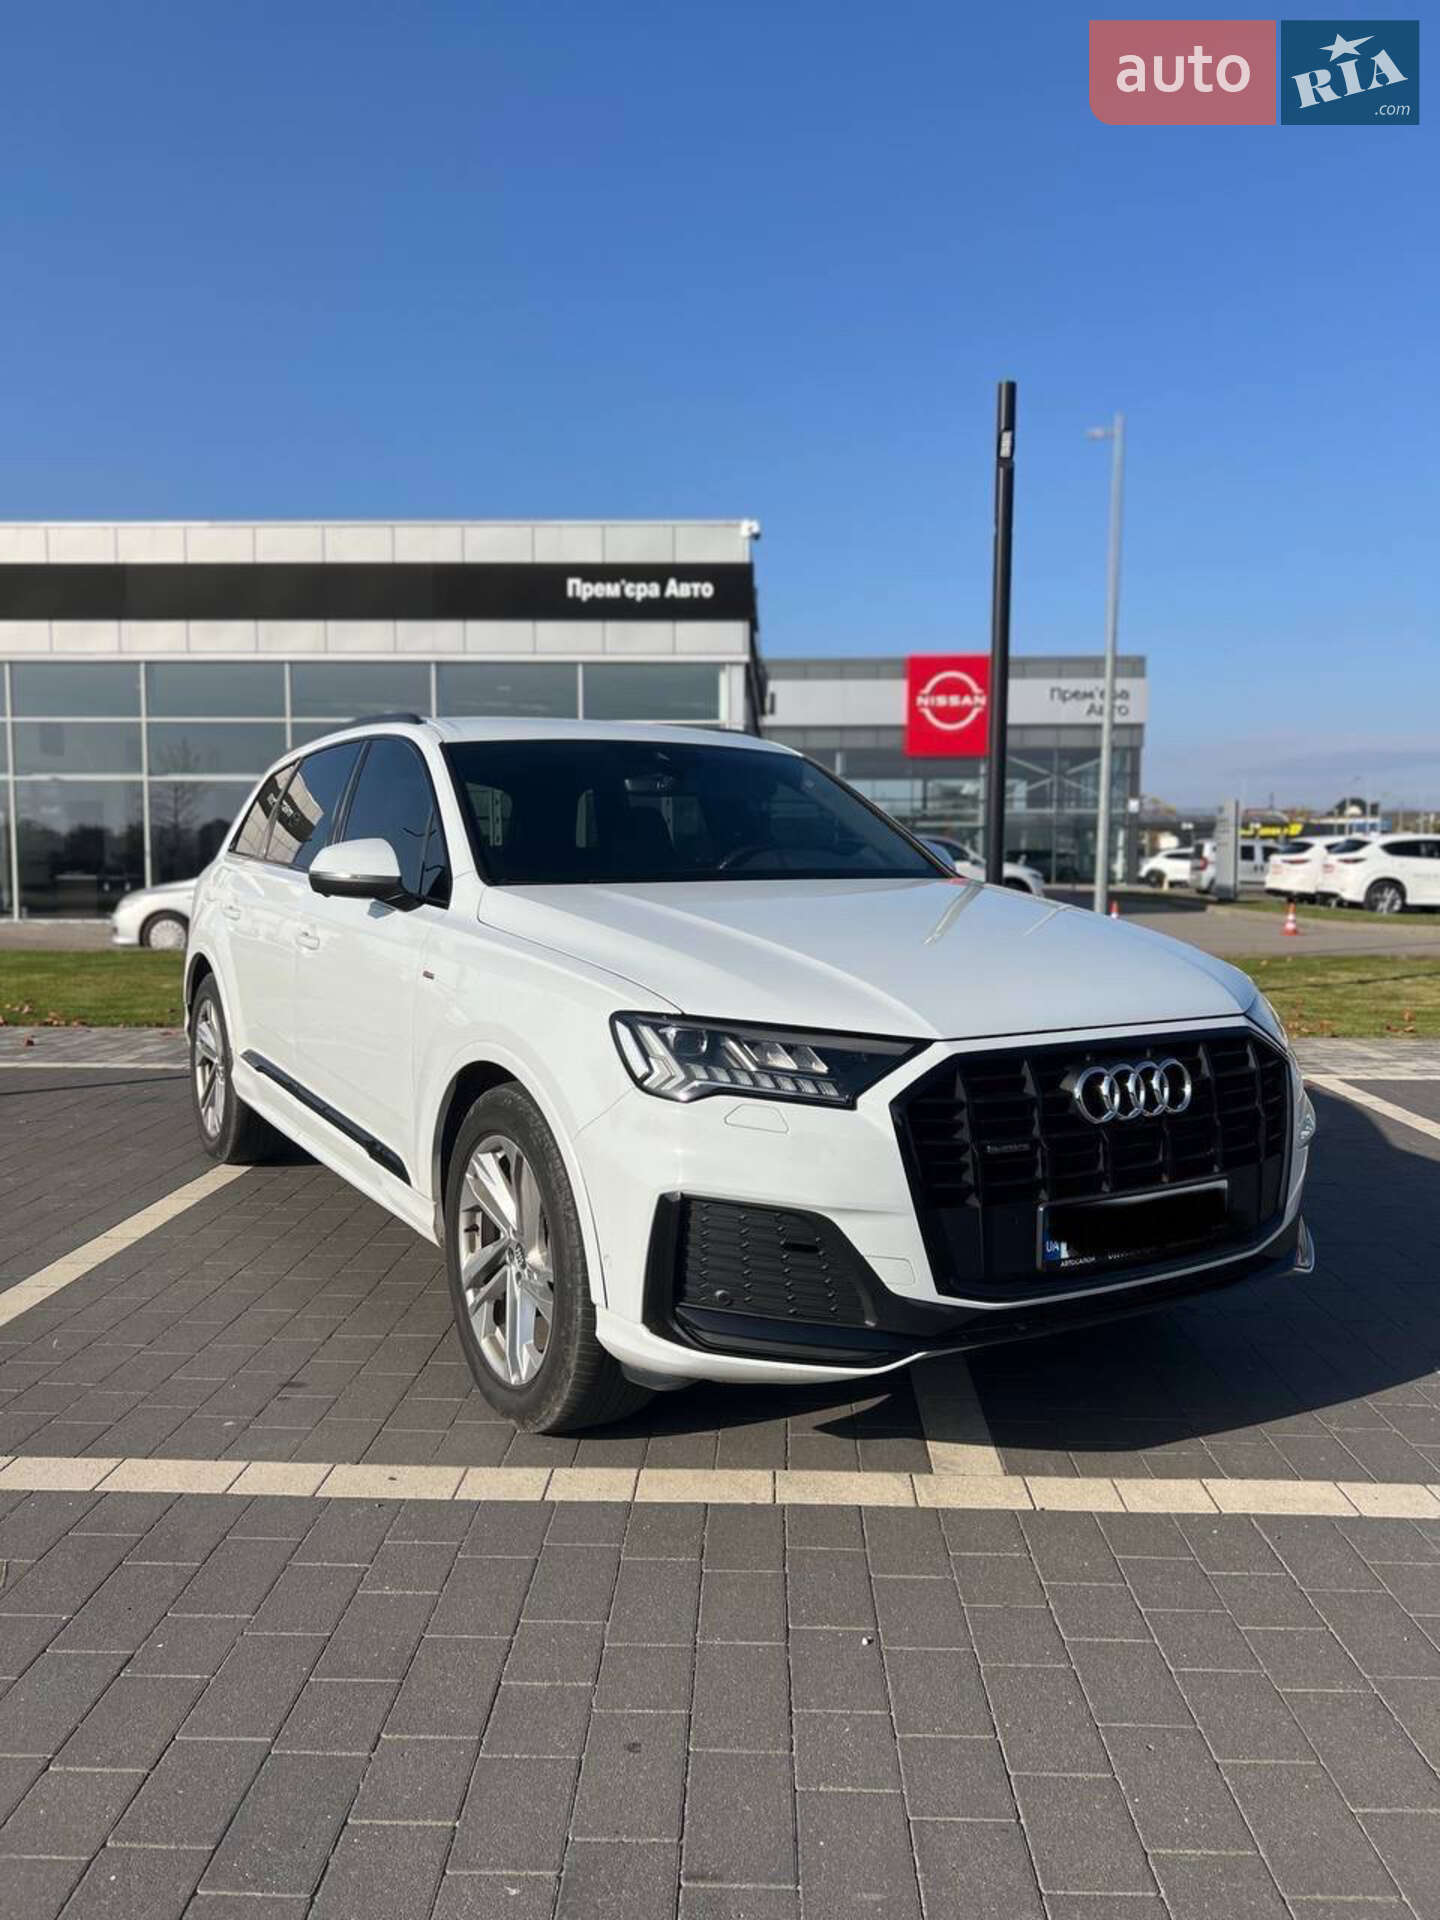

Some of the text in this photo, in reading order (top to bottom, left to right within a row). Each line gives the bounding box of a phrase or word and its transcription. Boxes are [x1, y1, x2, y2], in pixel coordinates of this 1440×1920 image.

[664, 577, 715, 598] Авто
[916, 694, 987, 707] NISSAN
[1045, 1240, 1060, 1252] UA
